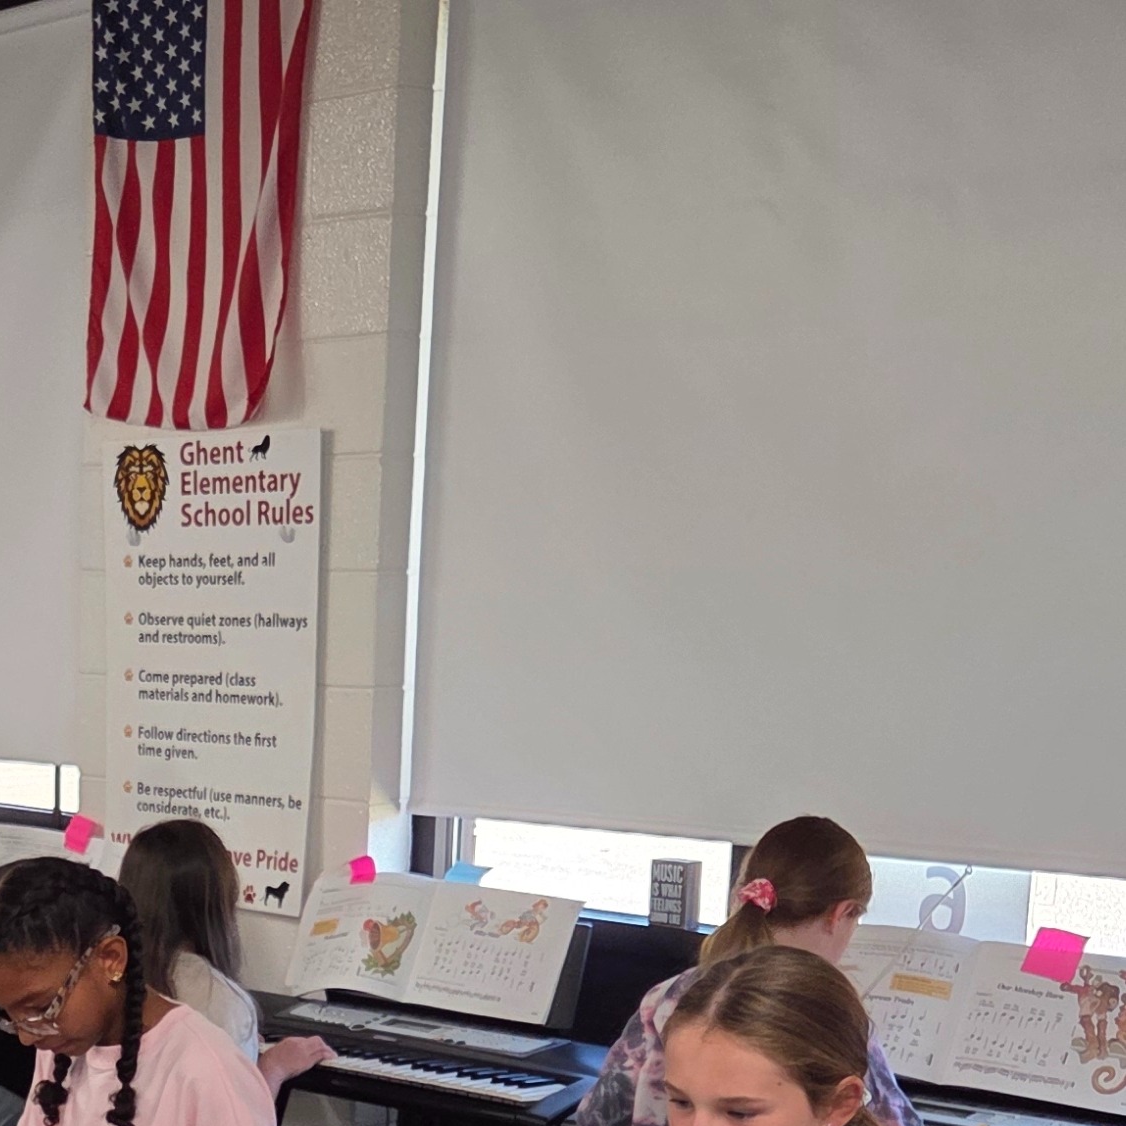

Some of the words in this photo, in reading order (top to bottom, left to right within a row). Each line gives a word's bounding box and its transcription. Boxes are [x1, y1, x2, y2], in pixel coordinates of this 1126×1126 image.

[180, 441, 244, 465] Ghent
[180, 470, 301, 498] Elementary
[180, 500, 251, 527] School
[258, 499, 314, 526] Rules
[138, 555, 166, 571] Keep
[169, 554, 206, 569] hands,
[209, 553, 234, 567] feet,
[237, 552, 259, 566] and
[262, 552, 276, 566] all
[138, 572, 179, 588] objects
[182, 573, 193, 585] to
[196, 571, 245, 588] yourself.
[138, 613, 184, 627] Observe
[186, 614, 216, 632] quiet
[219, 616, 251, 627] zones
[254, 613, 308, 631] (hallways
[138, 631, 159, 643] and
[162, 631, 226, 646] restrooms).
[138, 670, 169, 684] Come
[172, 671, 223, 687] prepared
[225, 673, 256, 687] (class
[138, 688, 189, 702] materials
[191, 690, 212, 702] and
[215, 690, 283, 708] homework).
[138, 727, 173, 741] Follow
[176, 729, 231, 745] directions
[233, 733, 251, 747] the
[254, 733, 277, 748] first
[138, 744, 162, 757] time
[164, 745, 198, 761] given.
[137, 782, 151, 795] Be
[153, 785, 207, 803] respectful
[209, 788, 232, 804] (use
[234, 793, 285, 810] manners,
[288, 795, 302, 810] be
[137, 801, 201, 819] considerate,
[204, 807, 230, 822] etc.).
[256, 849, 298, 873] Pride
[653, 863, 683, 883] MUSIC
